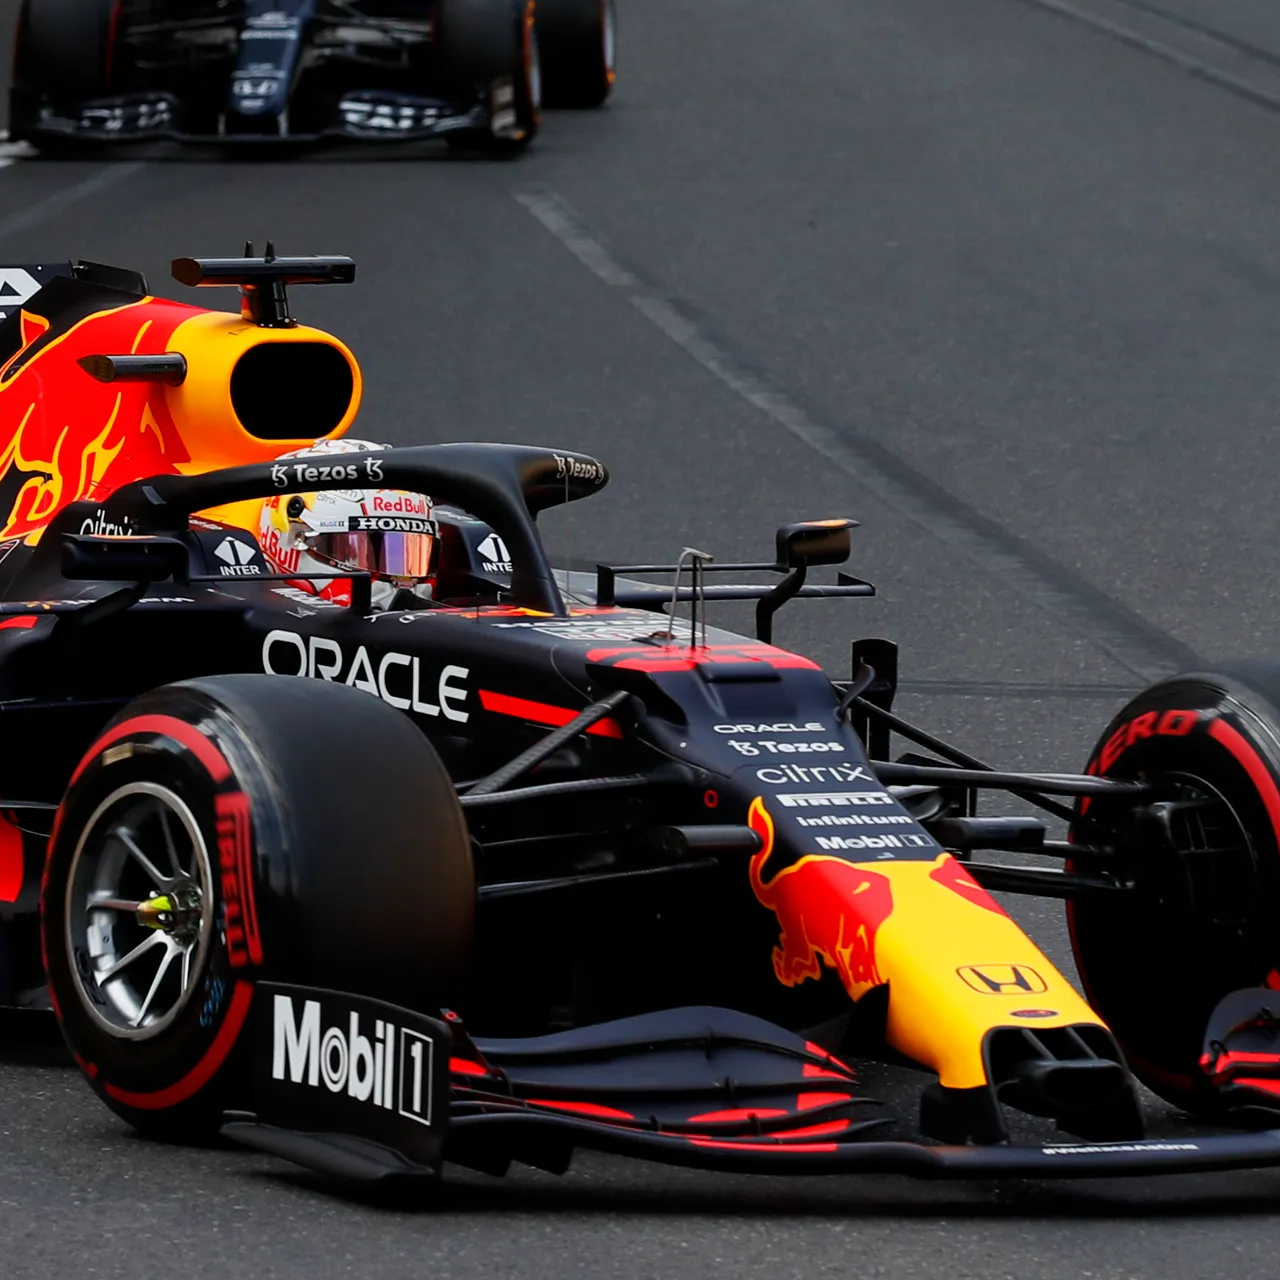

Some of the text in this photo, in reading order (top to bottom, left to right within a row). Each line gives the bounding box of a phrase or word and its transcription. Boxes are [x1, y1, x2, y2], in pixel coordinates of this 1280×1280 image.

[293, 463, 358, 483] Tezos
[567, 457, 597, 480] Tezos
[357, 517, 434, 534] HONDA
[220, 565, 262, 577] INTER
[482, 562, 514, 573] INTE
[262, 629, 470, 724] ORACLE
[713, 722, 826, 734] ORACLE
[757, 739, 845, 755] Tezos
[756, 762, 874, 785] citrix
[775, 791, 894, 808] PIRELLI
[797, 815, 914, 828] infinitum
[815, 834, 902, 851] Mobil
[214, 792, 263, 966] PIRELLI
[272, 994, 395, 1110] Mobil
